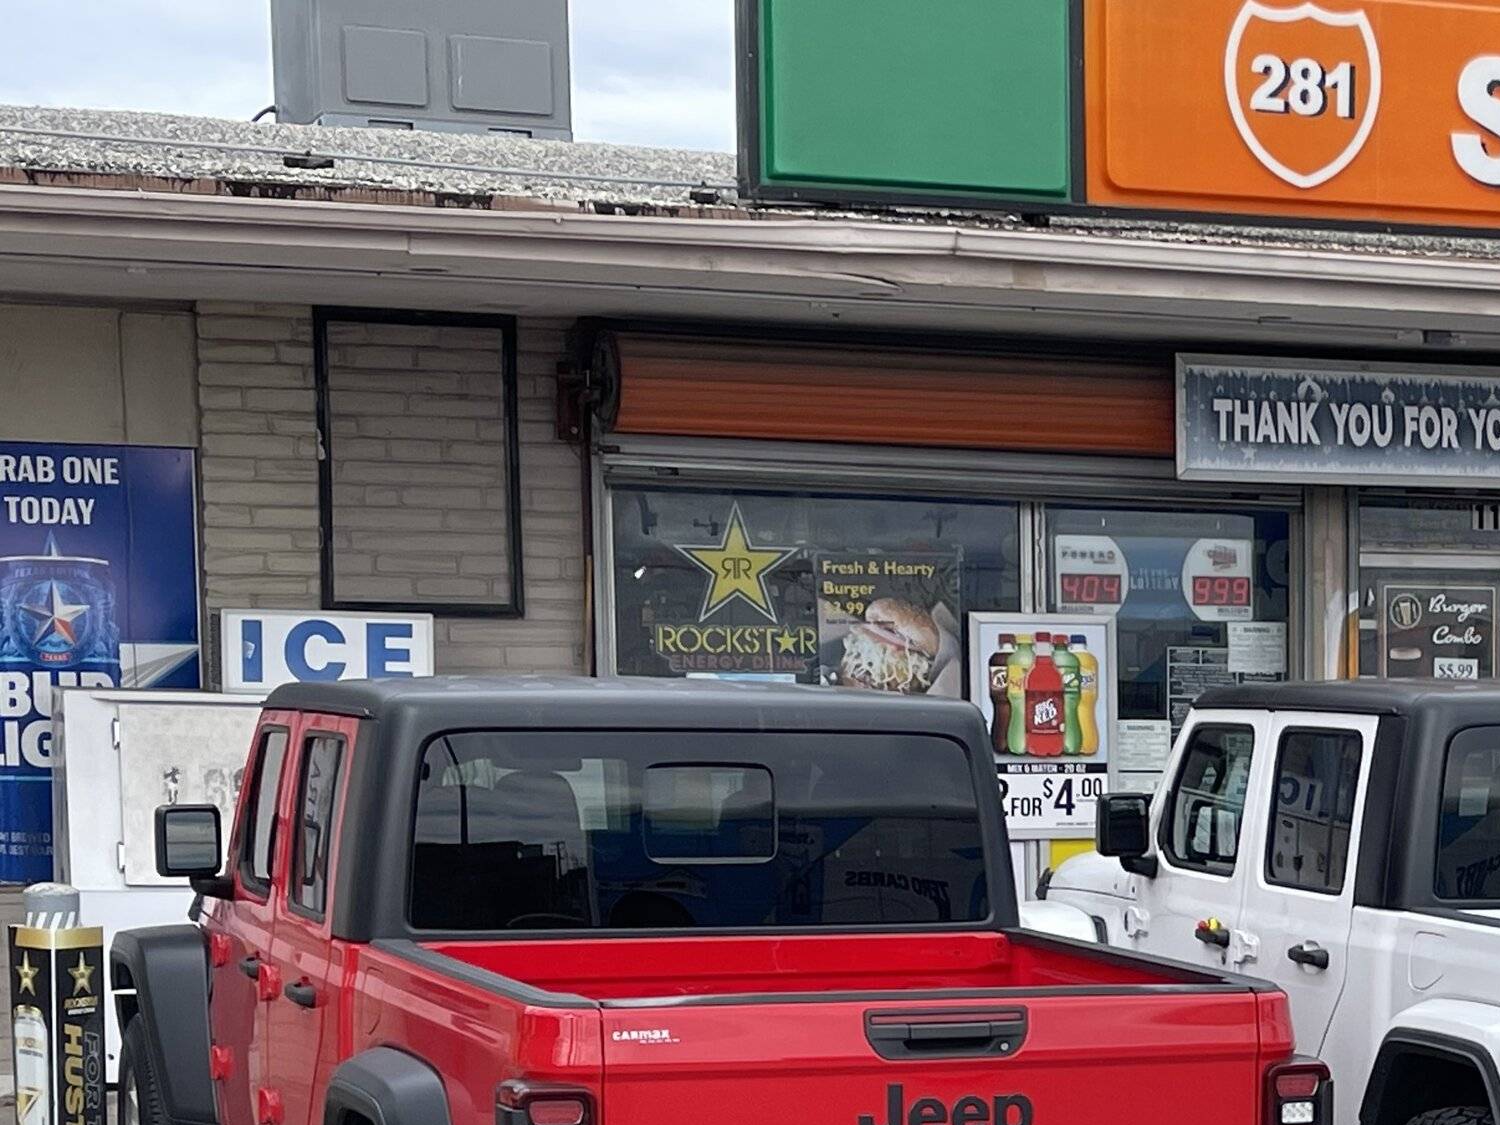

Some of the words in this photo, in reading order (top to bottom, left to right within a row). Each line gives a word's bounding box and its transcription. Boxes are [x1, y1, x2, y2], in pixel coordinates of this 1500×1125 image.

[1250, 54, 1355, 118] 281
[1213, 398, 1321, 446] THANK
[1330, 403, 1394, 447] YOU
[1404, 405, 1460, 449] FOR
[0, 455, 55, 483] RAB
[63, 457, 120, 485] ONE
[4, 496, 95, 525] TODAY
[822, 560, 864, 576] Fresh
[868, 561, 878, 574] &
[884, 561, 935, 578] Hearty
[823, 581, 876, 598] Burger
[1428, 594, 1487, 622] Burger
[1432, 626, 1482, 645] Combo
[241, 619, 413, 682] ICE
[671, 654, 744, 670] ENERGY
[752, 655, 807, 670] DRINK
[1011, 797, 1042, 817] FOR
[84, 1031, 99, 1109] FOR
